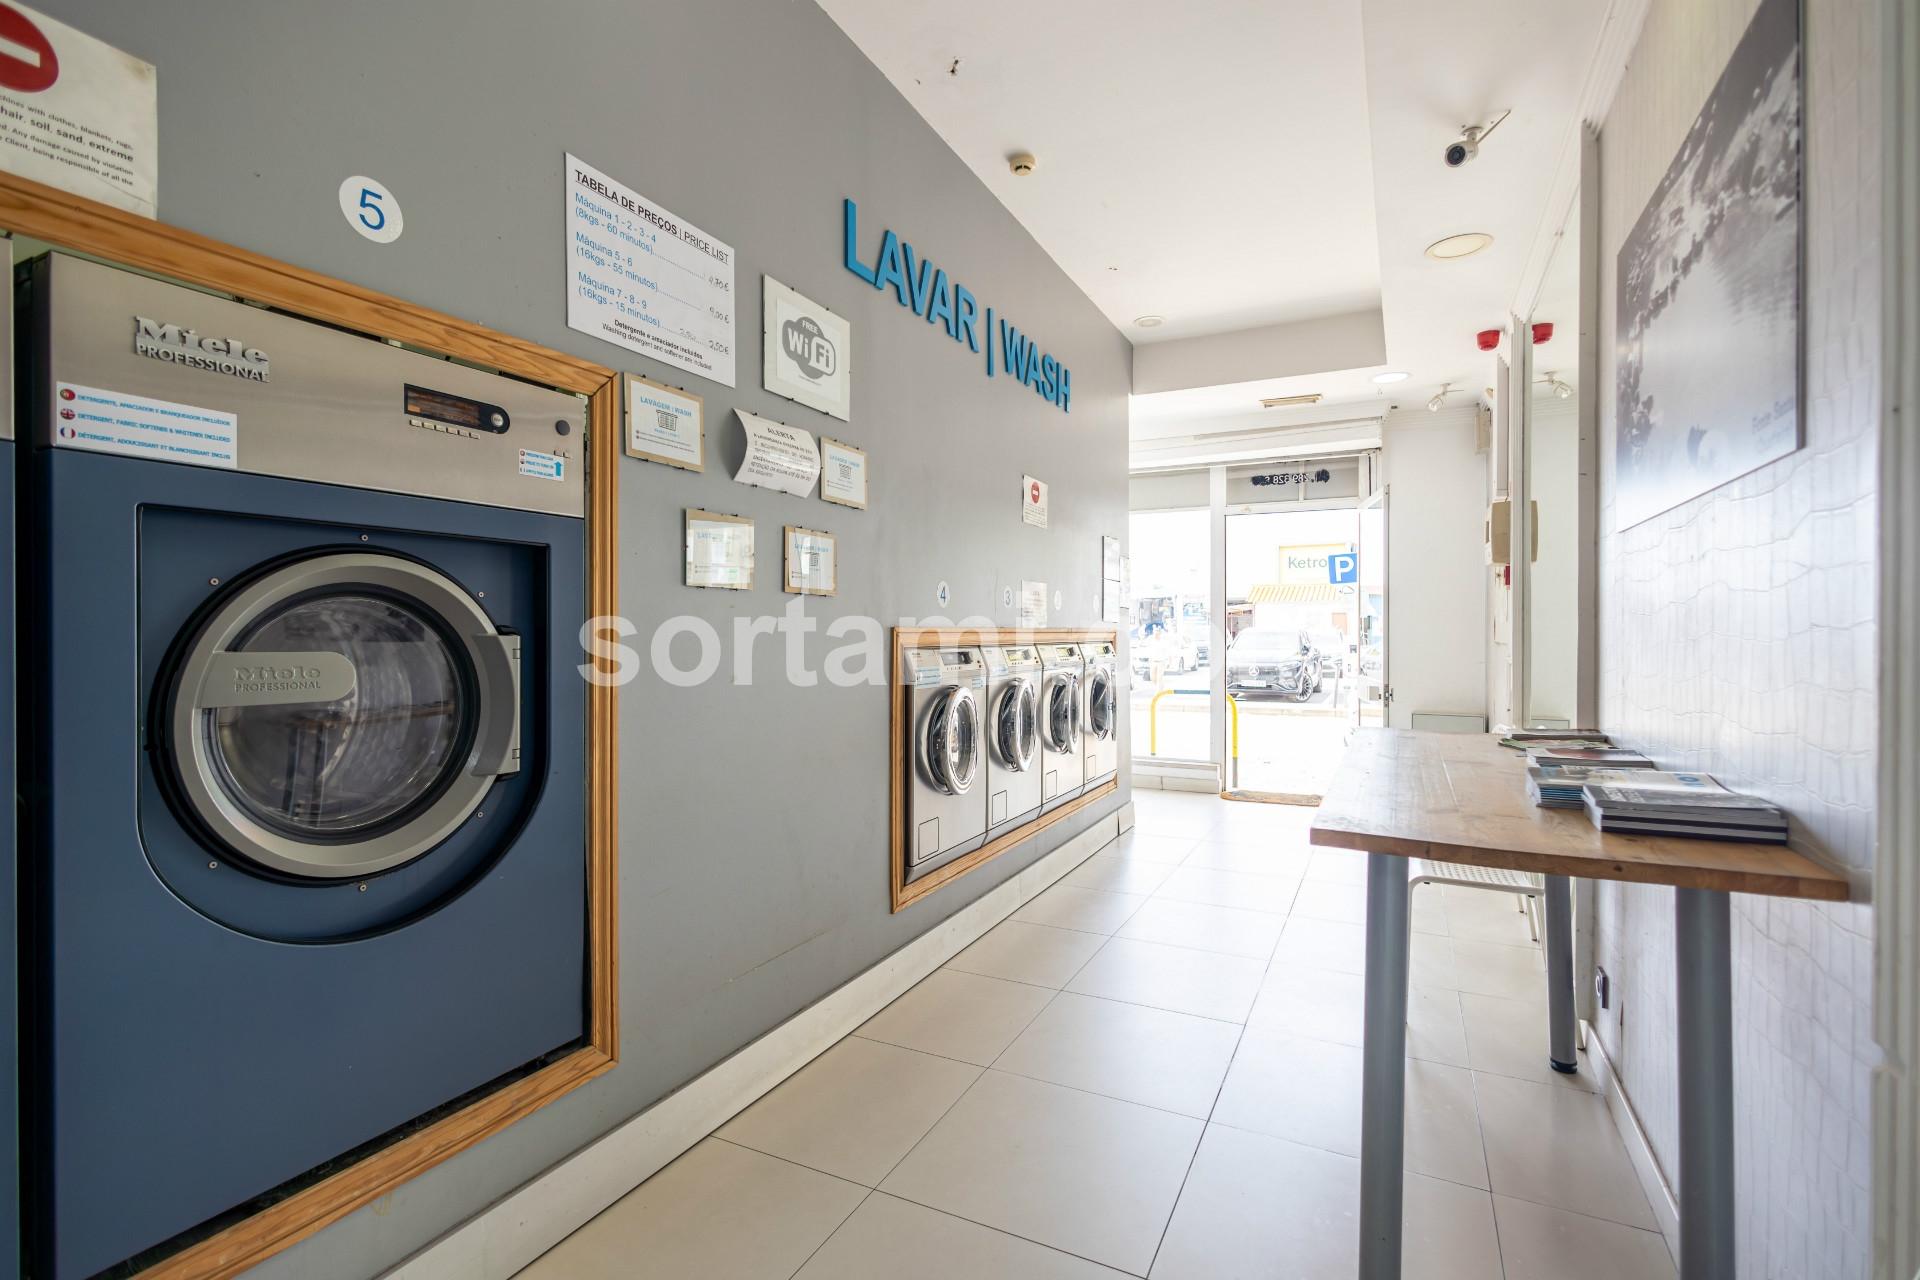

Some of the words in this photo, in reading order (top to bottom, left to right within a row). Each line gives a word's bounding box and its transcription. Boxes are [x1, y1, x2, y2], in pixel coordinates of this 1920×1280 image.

[12, 128, 28, 139] Any
[89, 141, 134, 162] extreme
[359, 188, 385, 230] 5
[575, 169, 618, 203] TABELA
[622, 196, 636, 212] DE
[638, 204, 677, 235] PREÇOS
[684, 231, 710, 254] PRICE
[712, 246, 728, 263] LIST
[576, 192, 612, 220] Máquina
[627, 220, 632, 231] 2
[640, 228, 645, 236] 3
[651, 234, 656, 243] 4
[576, 206, 600, 226] (8kgs
[606, 222, 618, 235] 60
[576, 232, 612, 257] Máquina
[614, 250, 620, 260] 5
[628, 256, 633, 267] 6
[576, 246, 605, 266] (16kgs
[613, 262, 624, 275] 55
[578, 272, 615, 296] Máquina
[617, 288, 622, 298] 7
[630, 294, 635, 304] 8
[642, 300, 647, 310] 9
[578, 286, 608, 305] (16kgs
[616, 301, 626, 313] 15
[844, 198, 980, 354] LAVAR
[1000, 318, 1072, 414] WASH
[134, 316, 268, 364] Miele
[602, 322, 626, 340] Washing
[802, 320, 818, 335] FREE
[136, 343, 270, 384] PROFESSIONAL
[640, 396, 670, 410] LAVAGEM
[674, 408, 692, 417] WASH
[1334, 556, 1354, 582] P
[940, 586, 946, 604] 4
[234, 665, 320, 681] Miele
[234, 681, 320, 693] PROFESSIONAL
